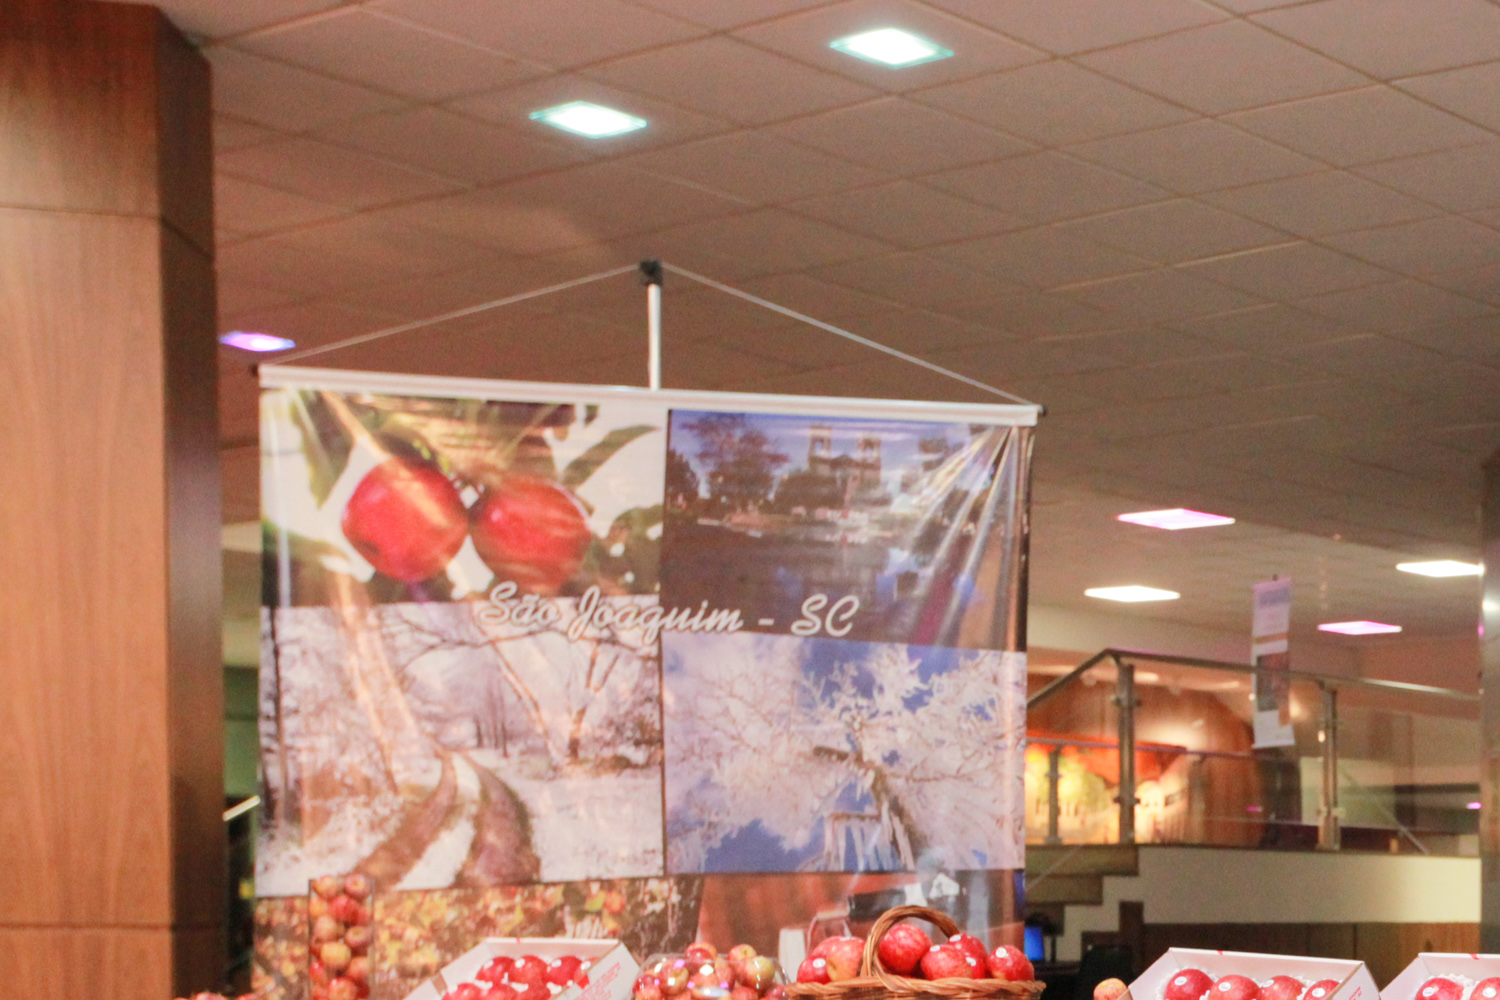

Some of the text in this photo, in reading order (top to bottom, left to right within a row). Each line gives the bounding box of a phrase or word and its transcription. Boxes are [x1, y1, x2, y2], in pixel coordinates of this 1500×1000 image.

[479, 581, 560, 627] São
[565, 584, 745, 645] Joaquim
[790, 593, 861, 638] SC
